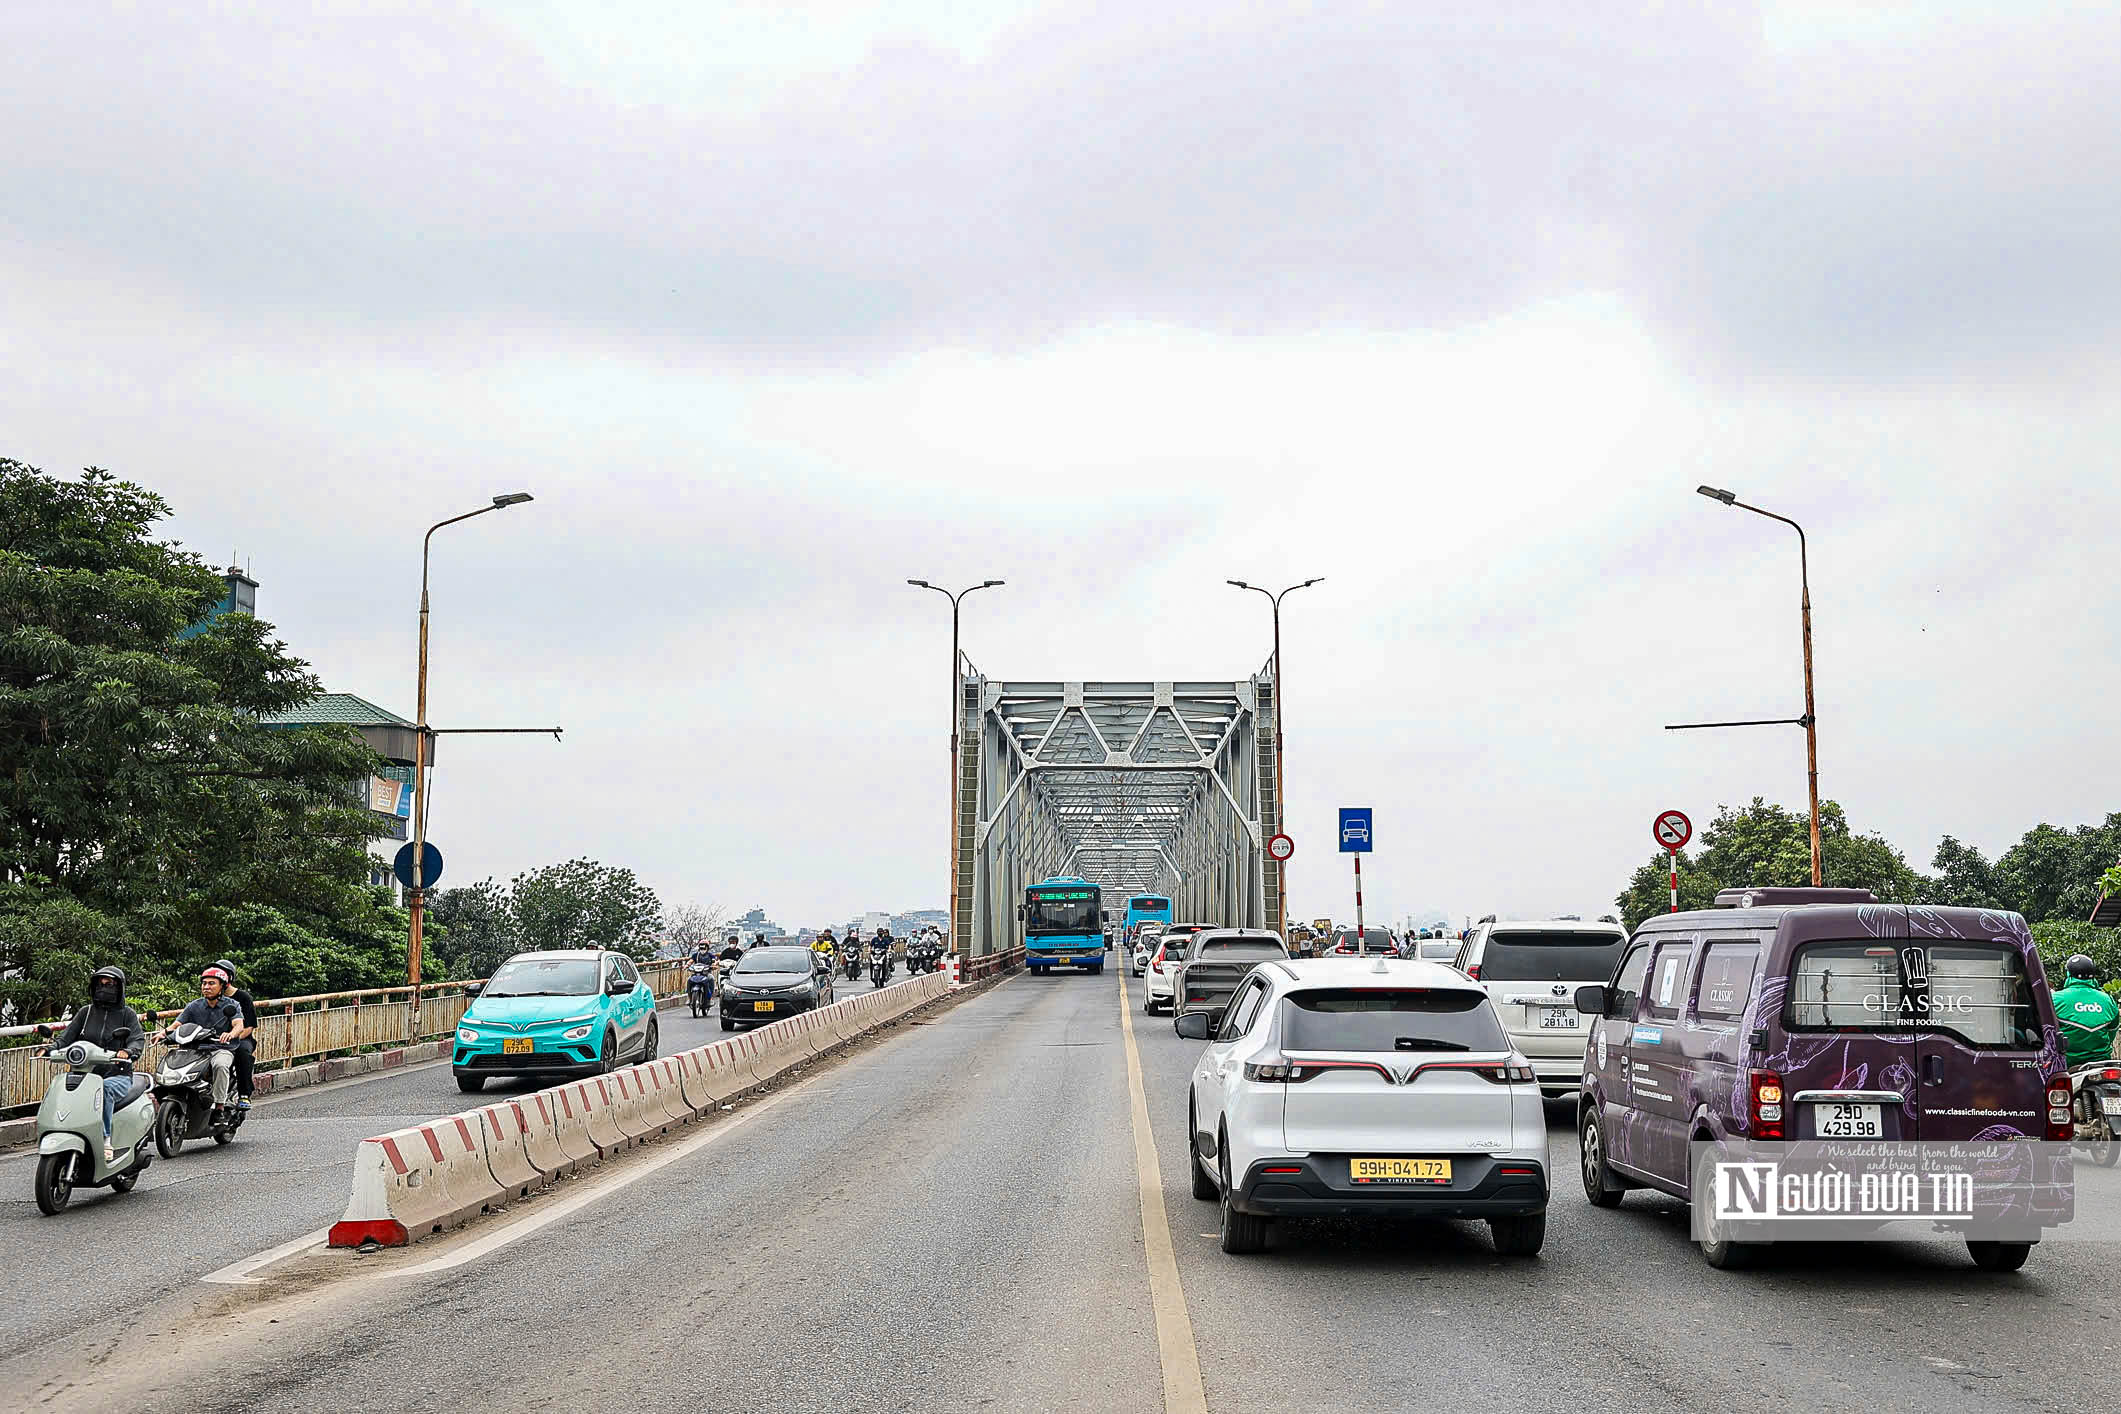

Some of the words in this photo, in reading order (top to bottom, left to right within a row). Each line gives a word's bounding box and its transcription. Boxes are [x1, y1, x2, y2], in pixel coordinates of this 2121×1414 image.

[1710, 990, 1734, 1002] CLASSIC
[1863, 994, 1973, 1013] CLASSIC
[2074, 1002, 2102, 1013] Grab
[1551, 1009, 1567, 1018] 29K
[1544, 1018, 1575, 1027] 281.18
[1833, 1105, 1862, 1119] 29D
[1925, 1107, 2036, 1117] www.classicfinefoods-vn.com
[1823, 1121, 1876, 1136] 429.98
[1827, 1144, 1846, 1157] We
[1848, 1144, 1876, 1157] select
[1878, 1144, 1896, 1157] the
[1897, 1144, 1918, 1157] best
[1922, 1145, 1948, 1160] from
[1950, 1145, 1967, 1158] the
[1969, 1145, 2000, 1158] world
[1359, 1161, 1444, 1176] 99H-041.72
[1866, 1158, 1887, 1171] and
[1889, 1159, 1916, 1174] bring
[1921, 1159, 1930, 1171] it
[1931, 1159, 1941, 1171] to
[1944, 1163, 1963, 1177] you
